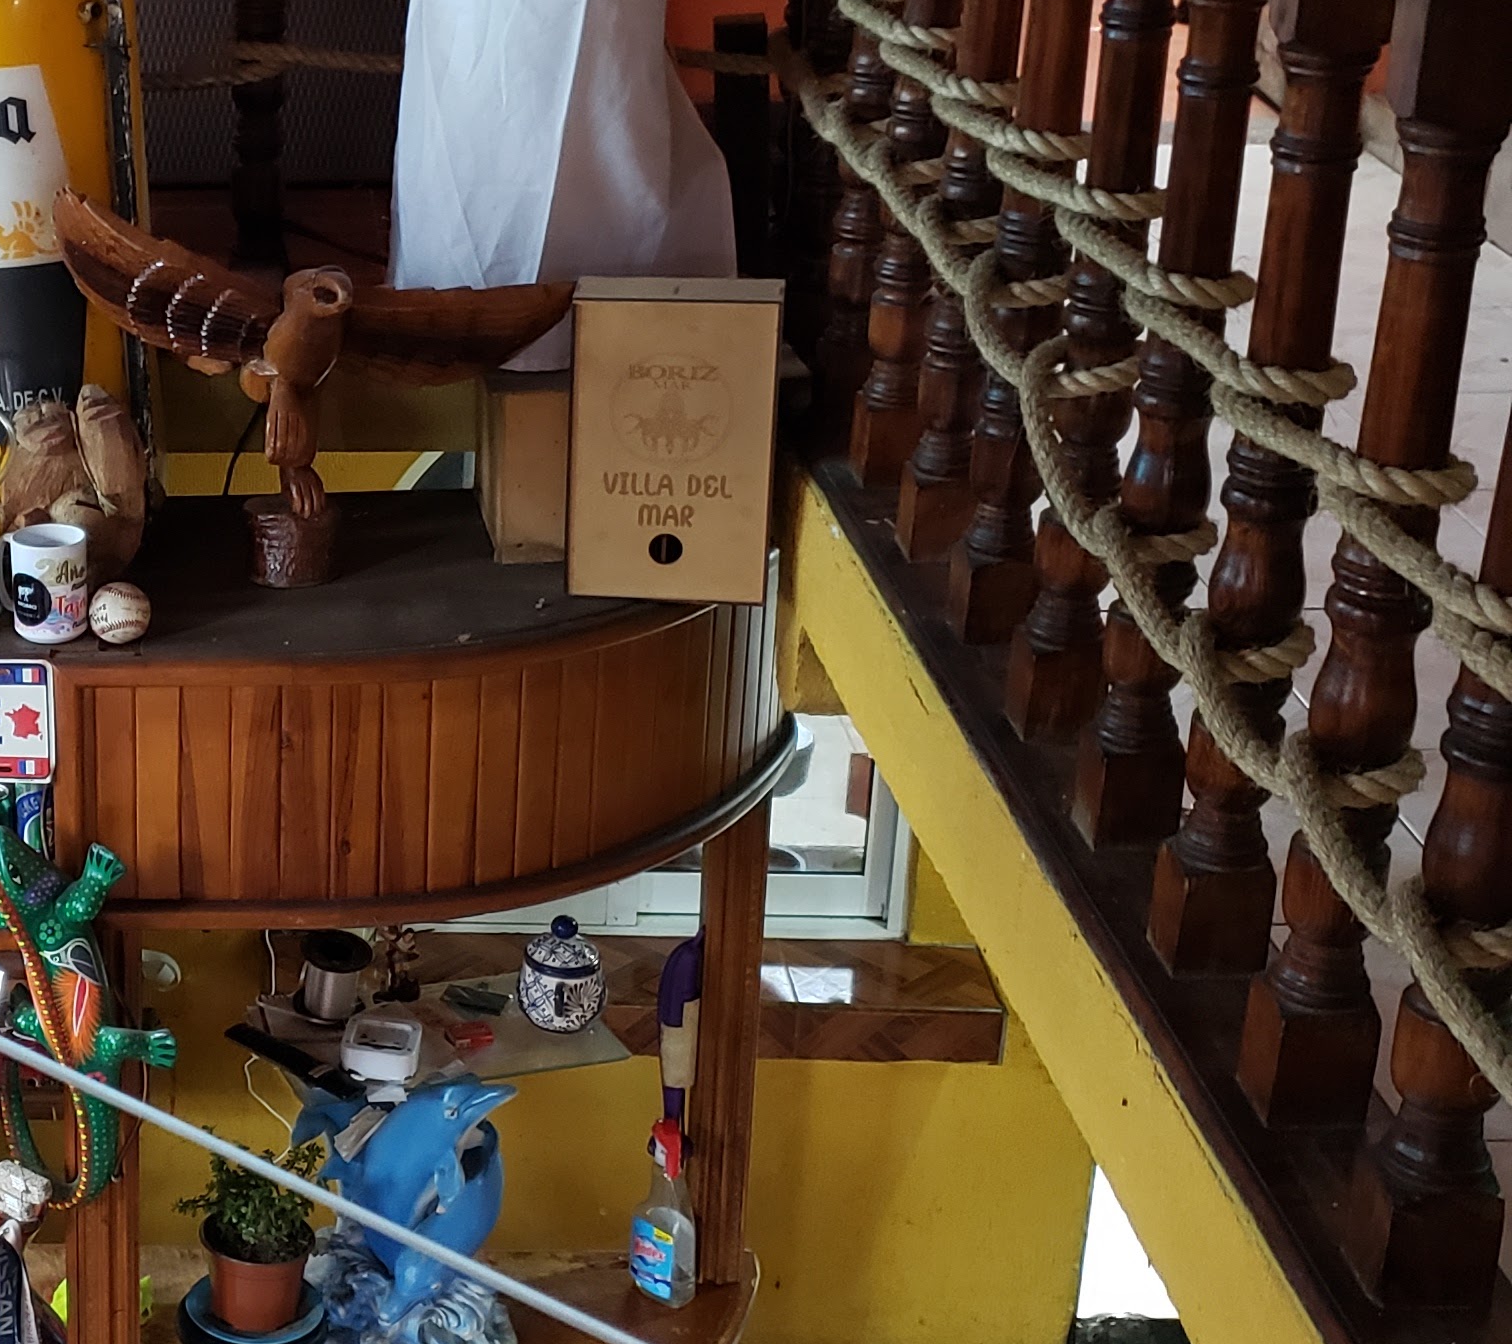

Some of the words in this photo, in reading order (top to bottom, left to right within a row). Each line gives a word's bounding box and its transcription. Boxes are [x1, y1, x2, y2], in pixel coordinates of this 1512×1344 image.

[603, 471, 674, 497] VILLA
[687, 474, 732, 499] DEL
[638, 505, 695, 528] MAR
